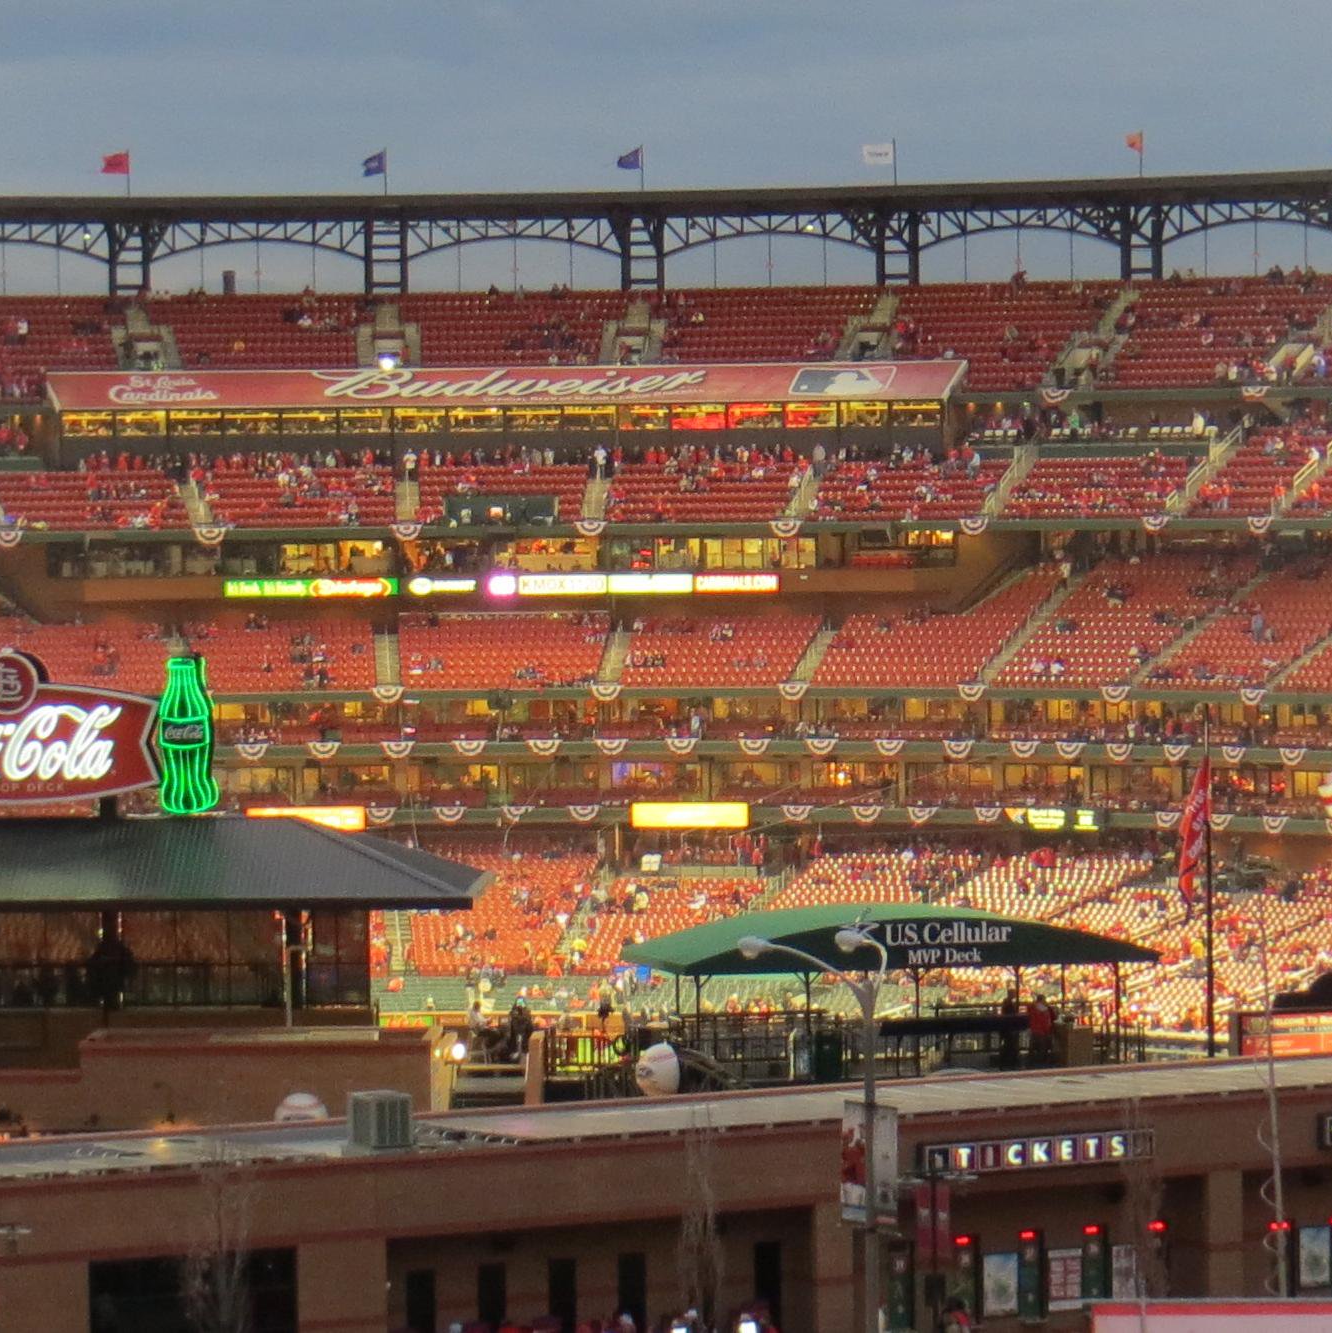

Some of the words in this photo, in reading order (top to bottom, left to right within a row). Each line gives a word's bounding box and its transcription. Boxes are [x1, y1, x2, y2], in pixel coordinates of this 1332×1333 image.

[108, 384, 219, 404] Cardinals
[310, 368, 706, 400] Budweiser
[26, 782, 65, 794] DECK
[923, 920, 1012, 944] Cellular
[908, 949, 941, 964] MVP
[945, 947, 982, 963] Deck
[956, 1135, 1127, 1169] TICKETS
